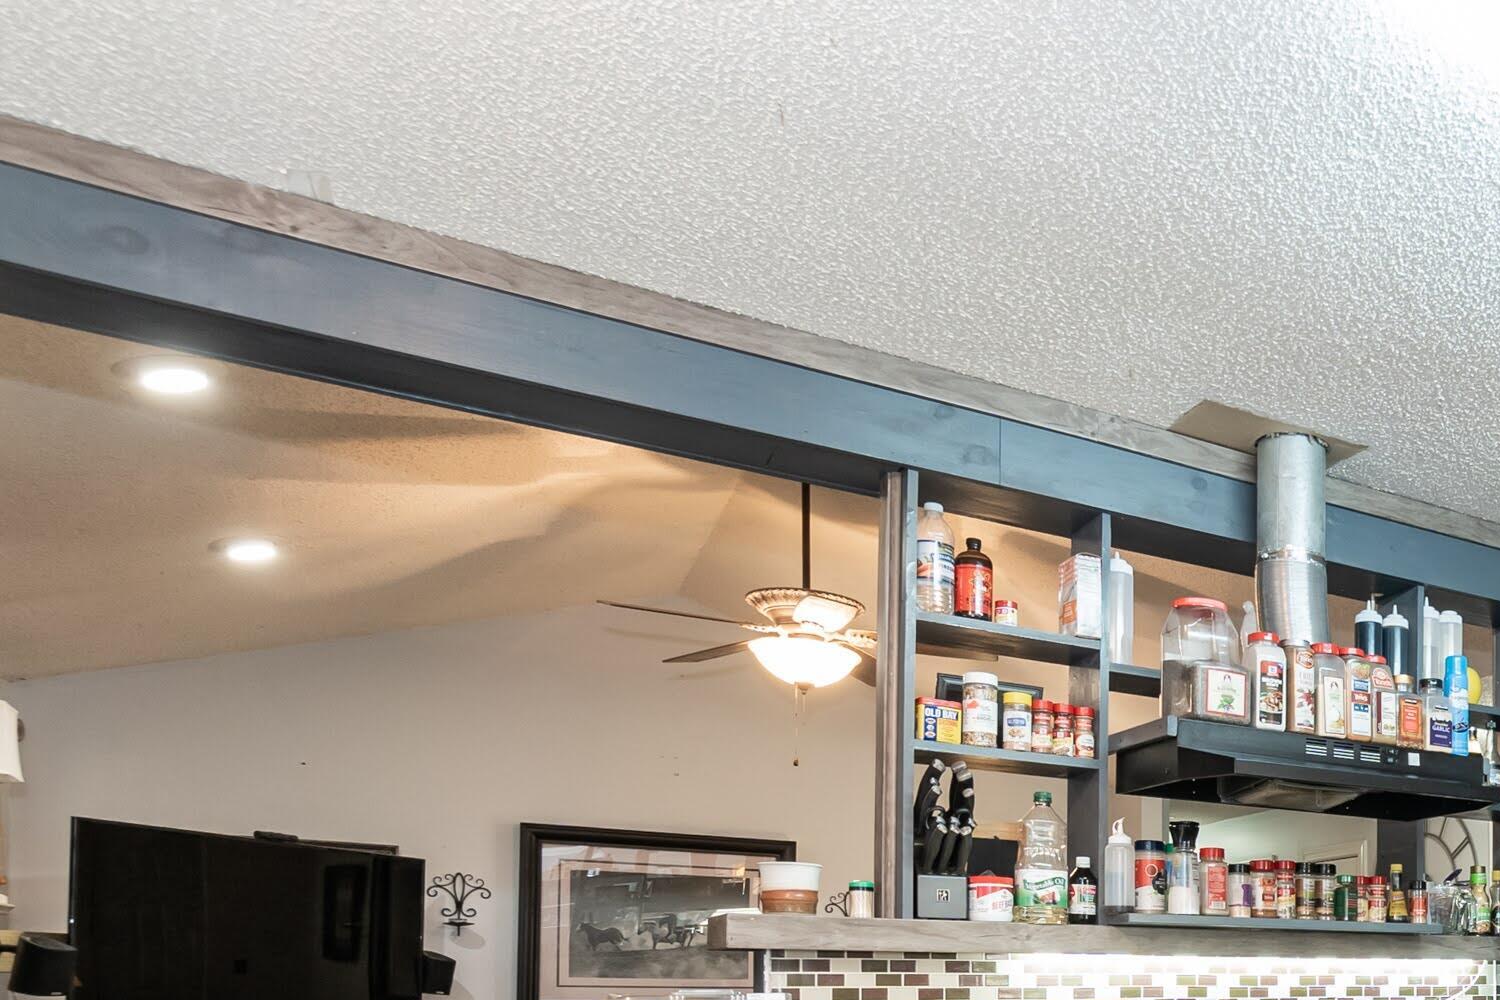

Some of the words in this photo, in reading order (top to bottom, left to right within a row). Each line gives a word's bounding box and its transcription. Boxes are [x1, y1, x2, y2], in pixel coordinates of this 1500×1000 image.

[925, 707, 941, 718] OLD
[942, 709, 958, 720] BAY
[1431, 724, 1451, 733] GARLIC
